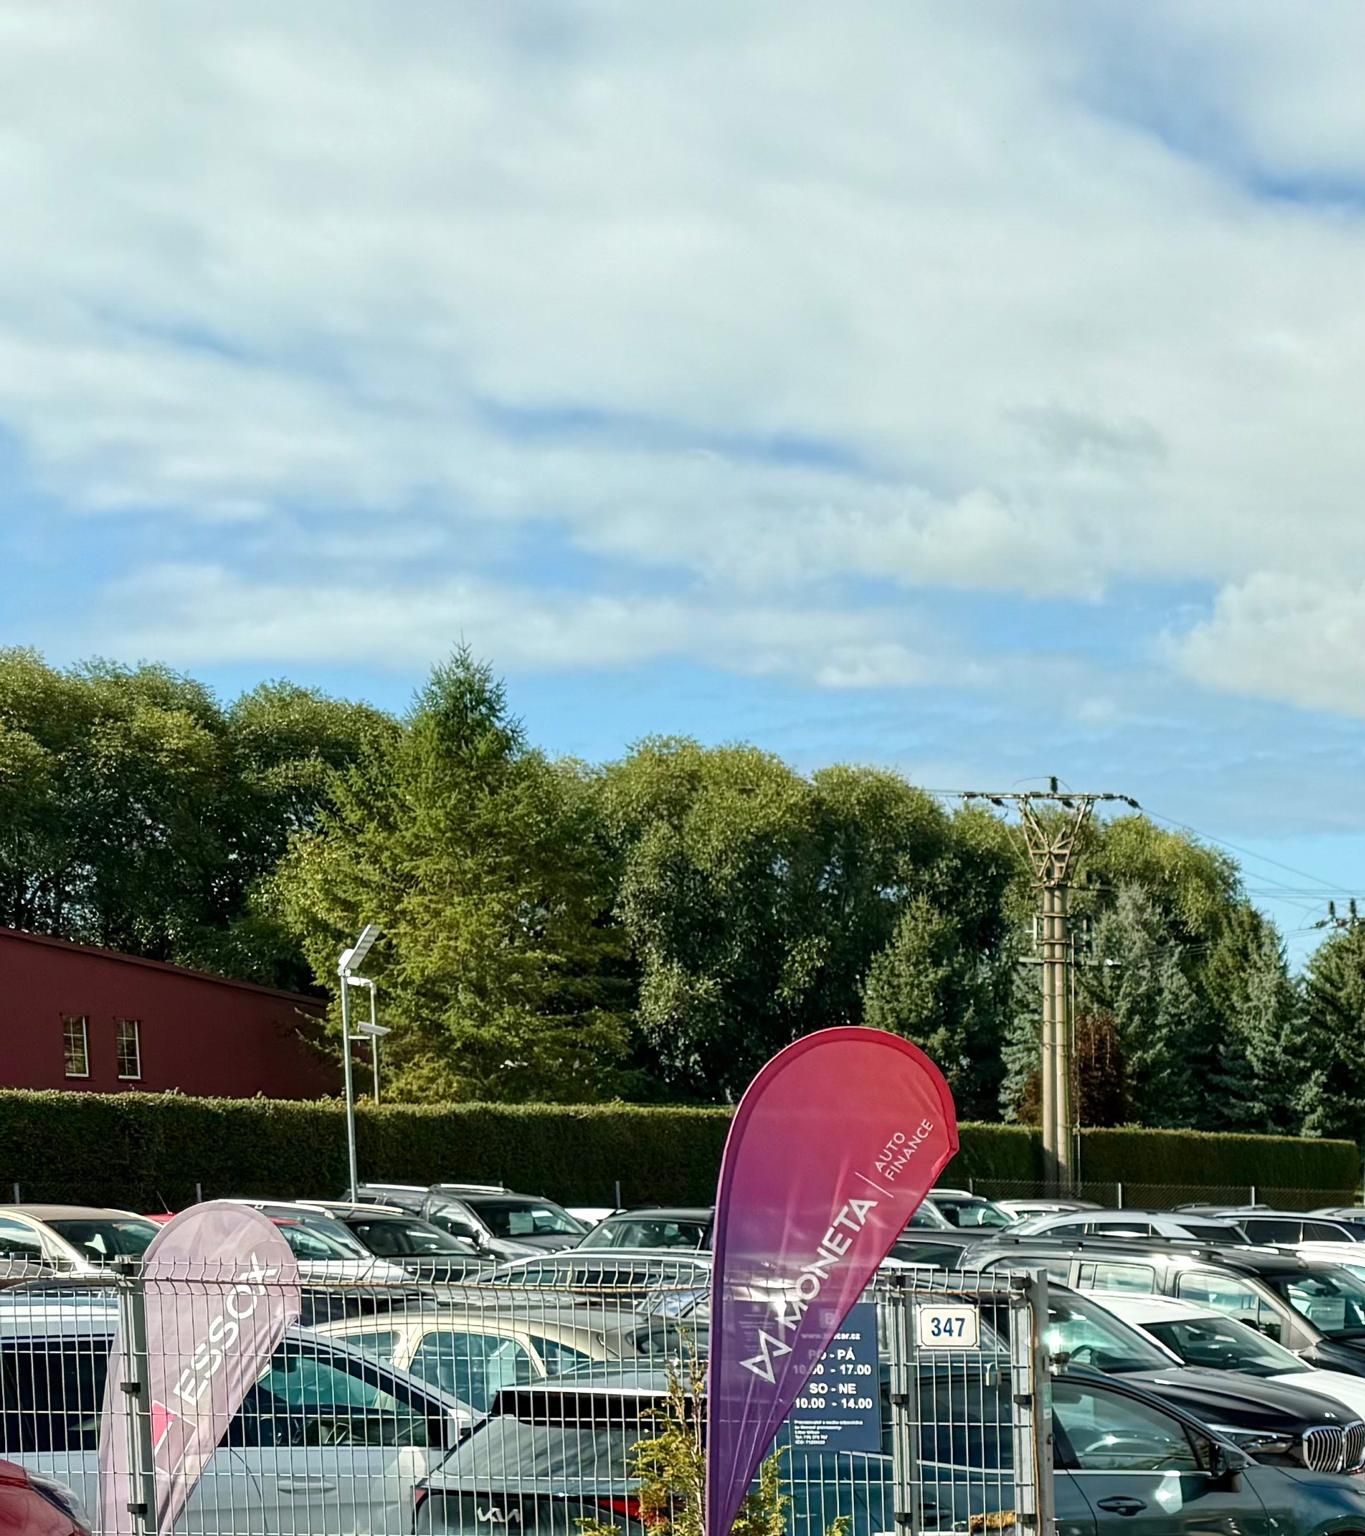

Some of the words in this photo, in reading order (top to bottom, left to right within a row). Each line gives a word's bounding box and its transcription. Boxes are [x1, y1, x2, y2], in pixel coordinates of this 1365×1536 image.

[874, 1132, 906, 1172] AUTO
[884, 1118, 934, 1181] FINANCE
[774, 1199, 879, 1331] MONETA
[172, 1252, 278, 1406] ESSOX
[930, 1316, 966, 1338] 347
[837, 1346, 856, 1361] PÁ
[793, 1363, 825, 1375] 1000
[840, 1363, 872, 1375] 17.00
[809, 1383, 828, 1395] SO
[838, 1383, 857, 1395] NE
[795, 1397, 826, 1409] 10.00
[841, 1397, 873, 1409] 14.00
